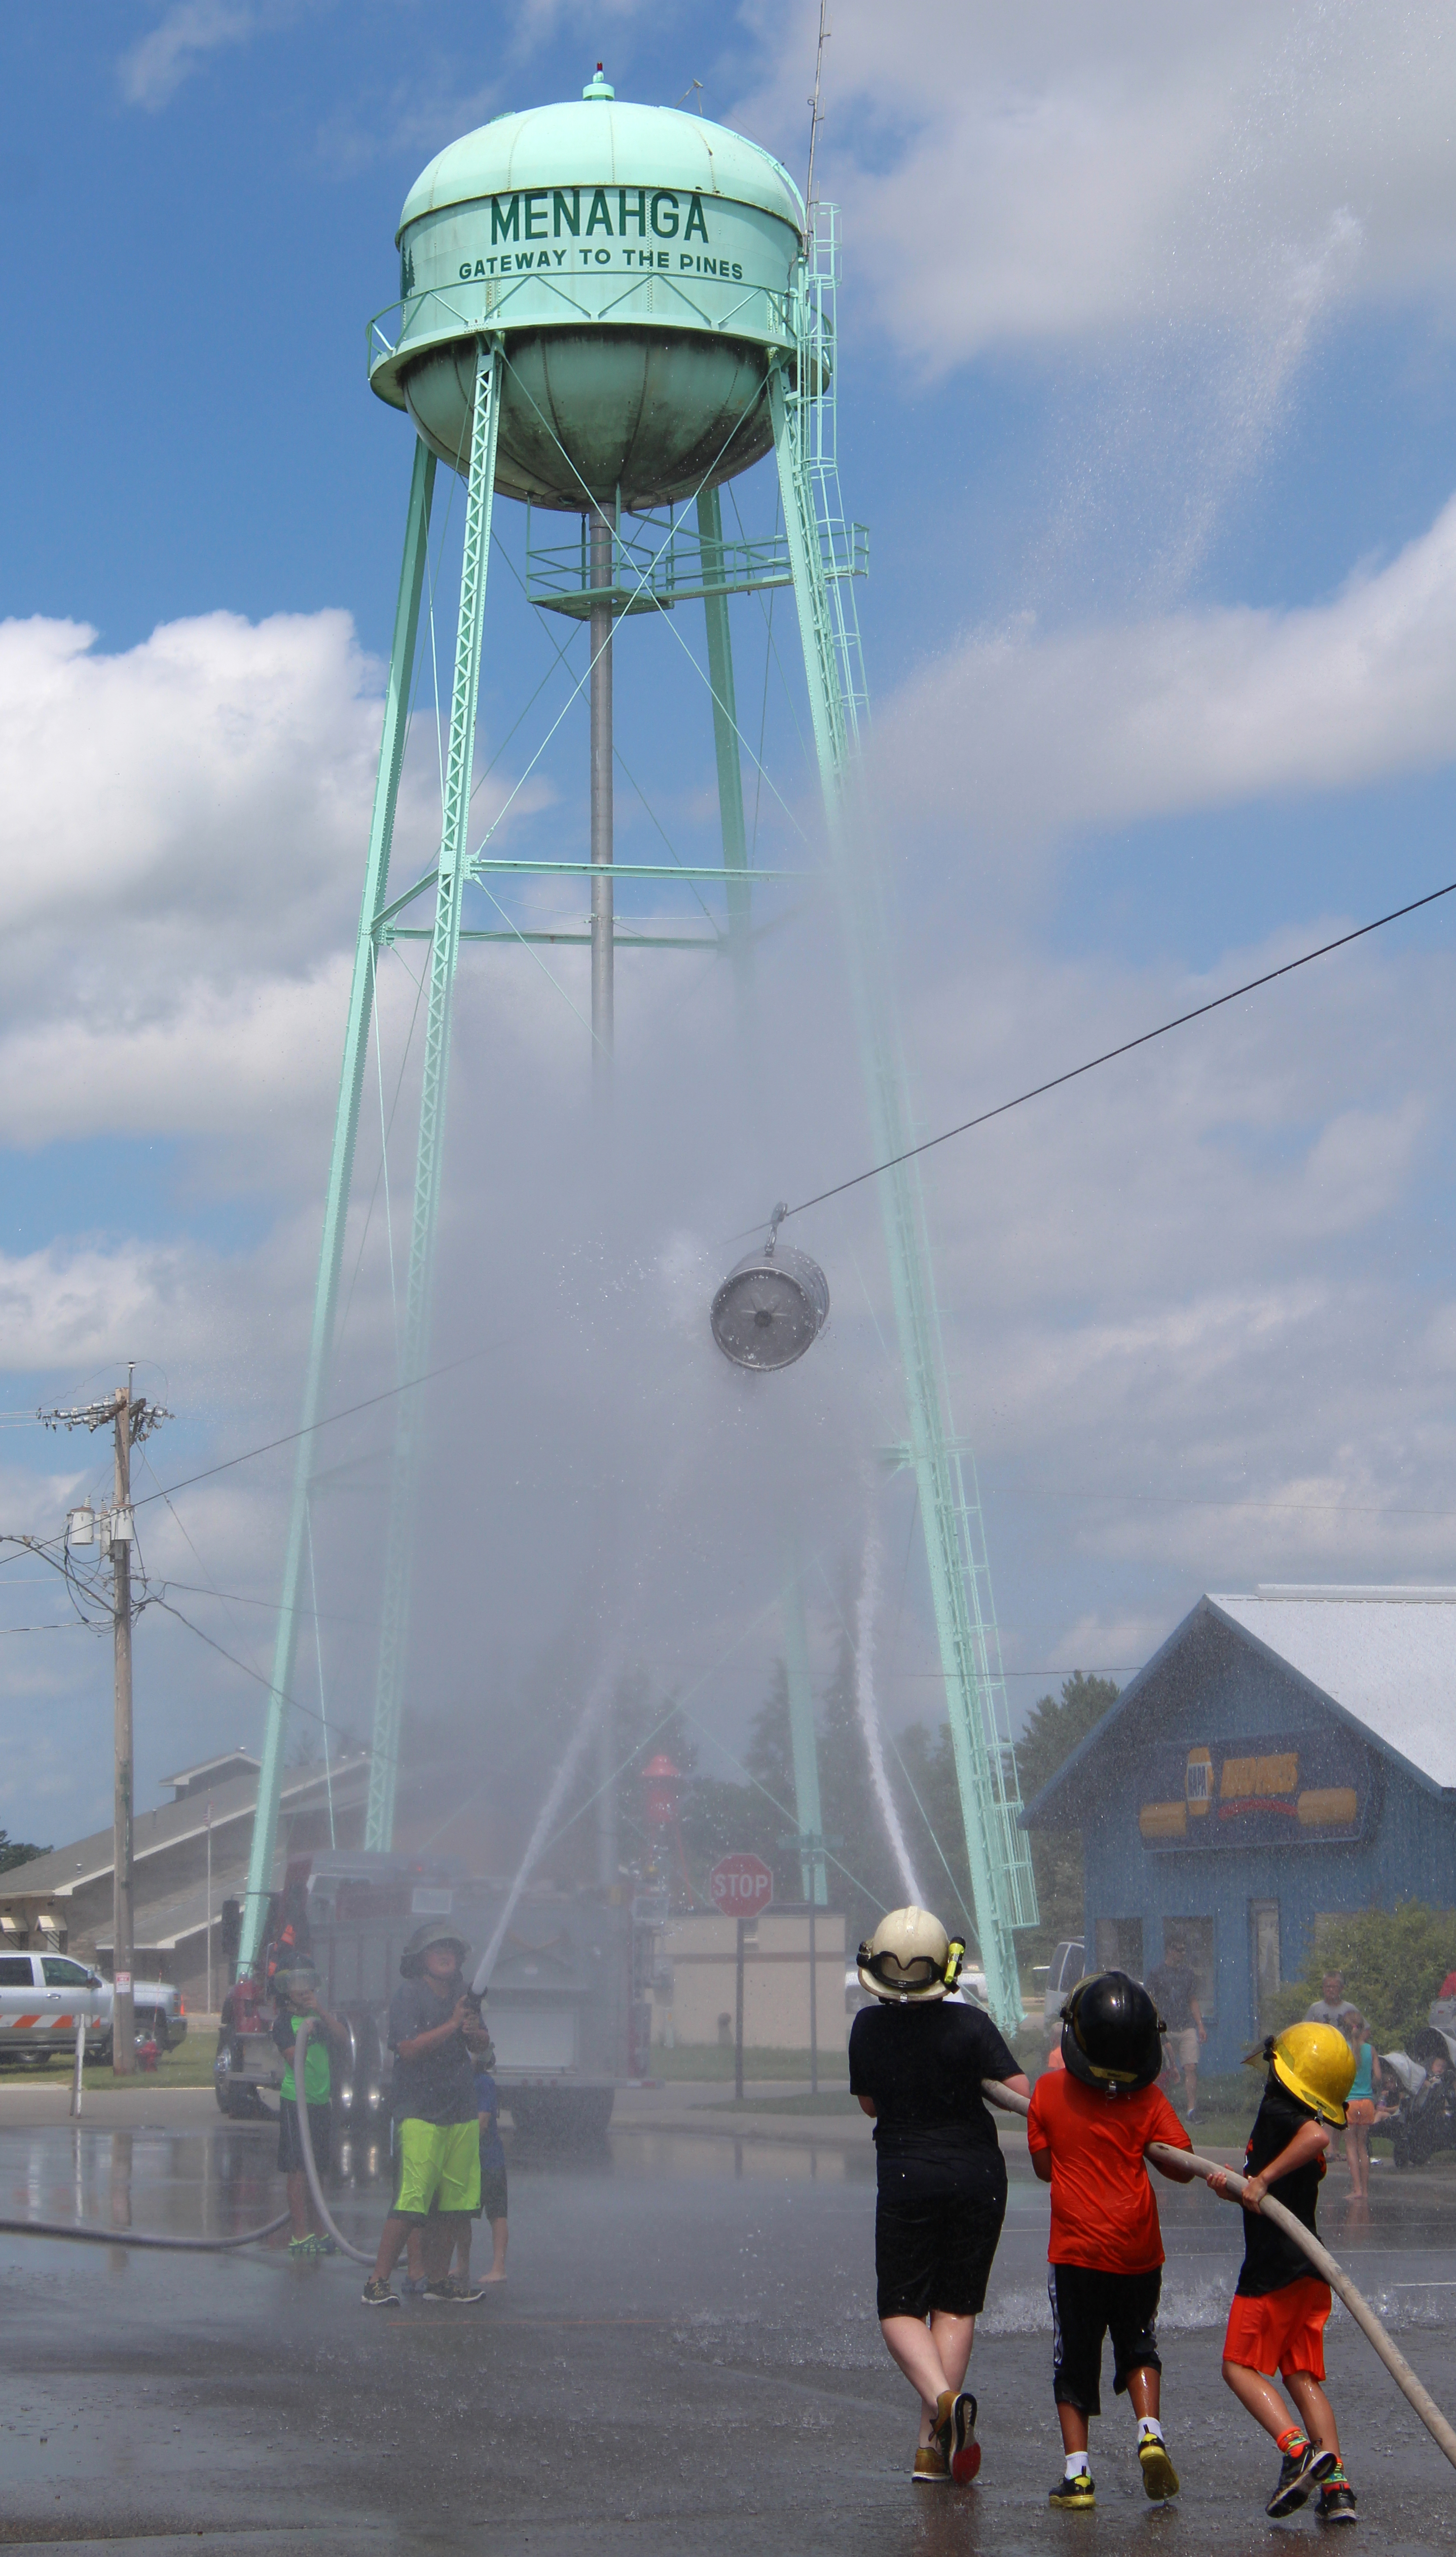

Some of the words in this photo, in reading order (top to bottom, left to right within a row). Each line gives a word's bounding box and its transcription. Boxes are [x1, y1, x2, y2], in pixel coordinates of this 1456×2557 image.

[491, 189, 709, 246] MENAHGA
[459, 249, 567, 280] GATEWAY
[579, 249, 611, 265] TO
[622, 249, 669, 268] THE
[680, 254, 743, 280] PINES
[714, 1873, 768, 1898] STOP
